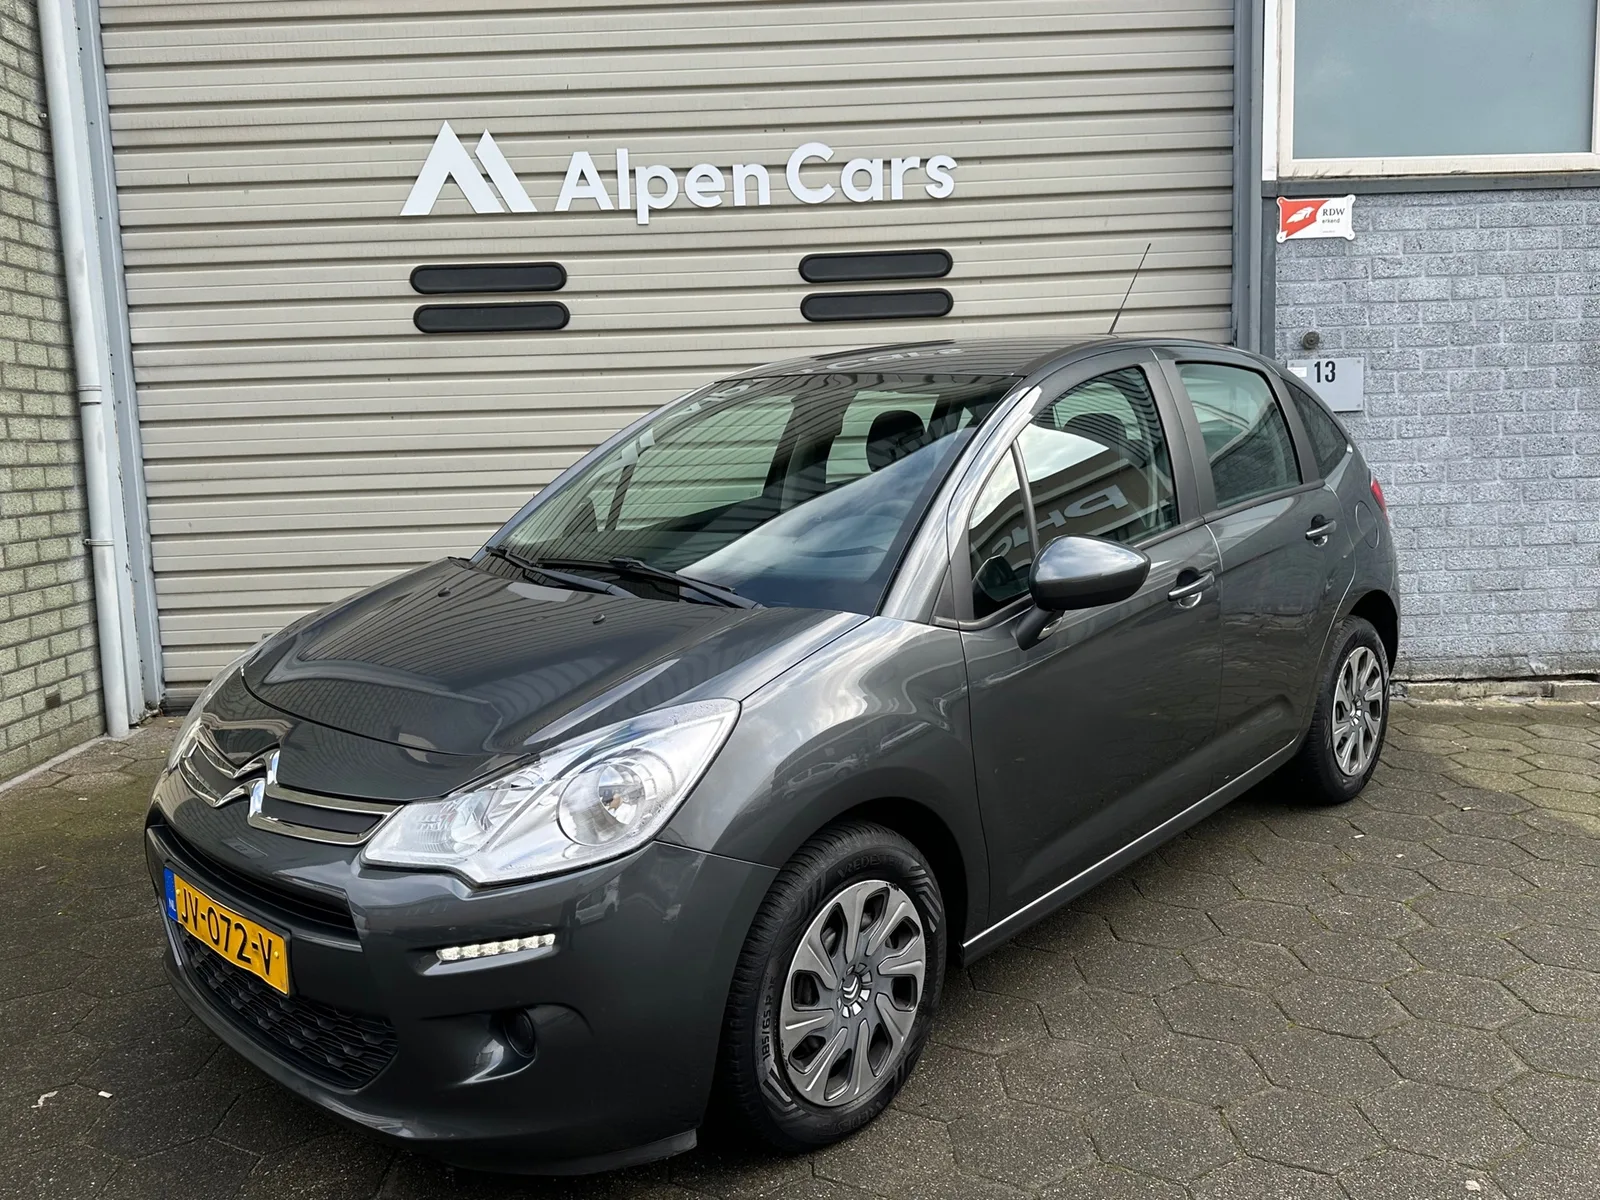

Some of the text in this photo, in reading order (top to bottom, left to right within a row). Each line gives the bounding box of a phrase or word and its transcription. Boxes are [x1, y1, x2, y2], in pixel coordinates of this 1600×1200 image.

[554, 142, 957, 225] Alpen Cars
[1322, 208, 1345, 216] RDW
[1314, 361, 1336, 383] 13
[169, 898, 177, 912] NL
[181, 888, 273, 976] JV-072-V
